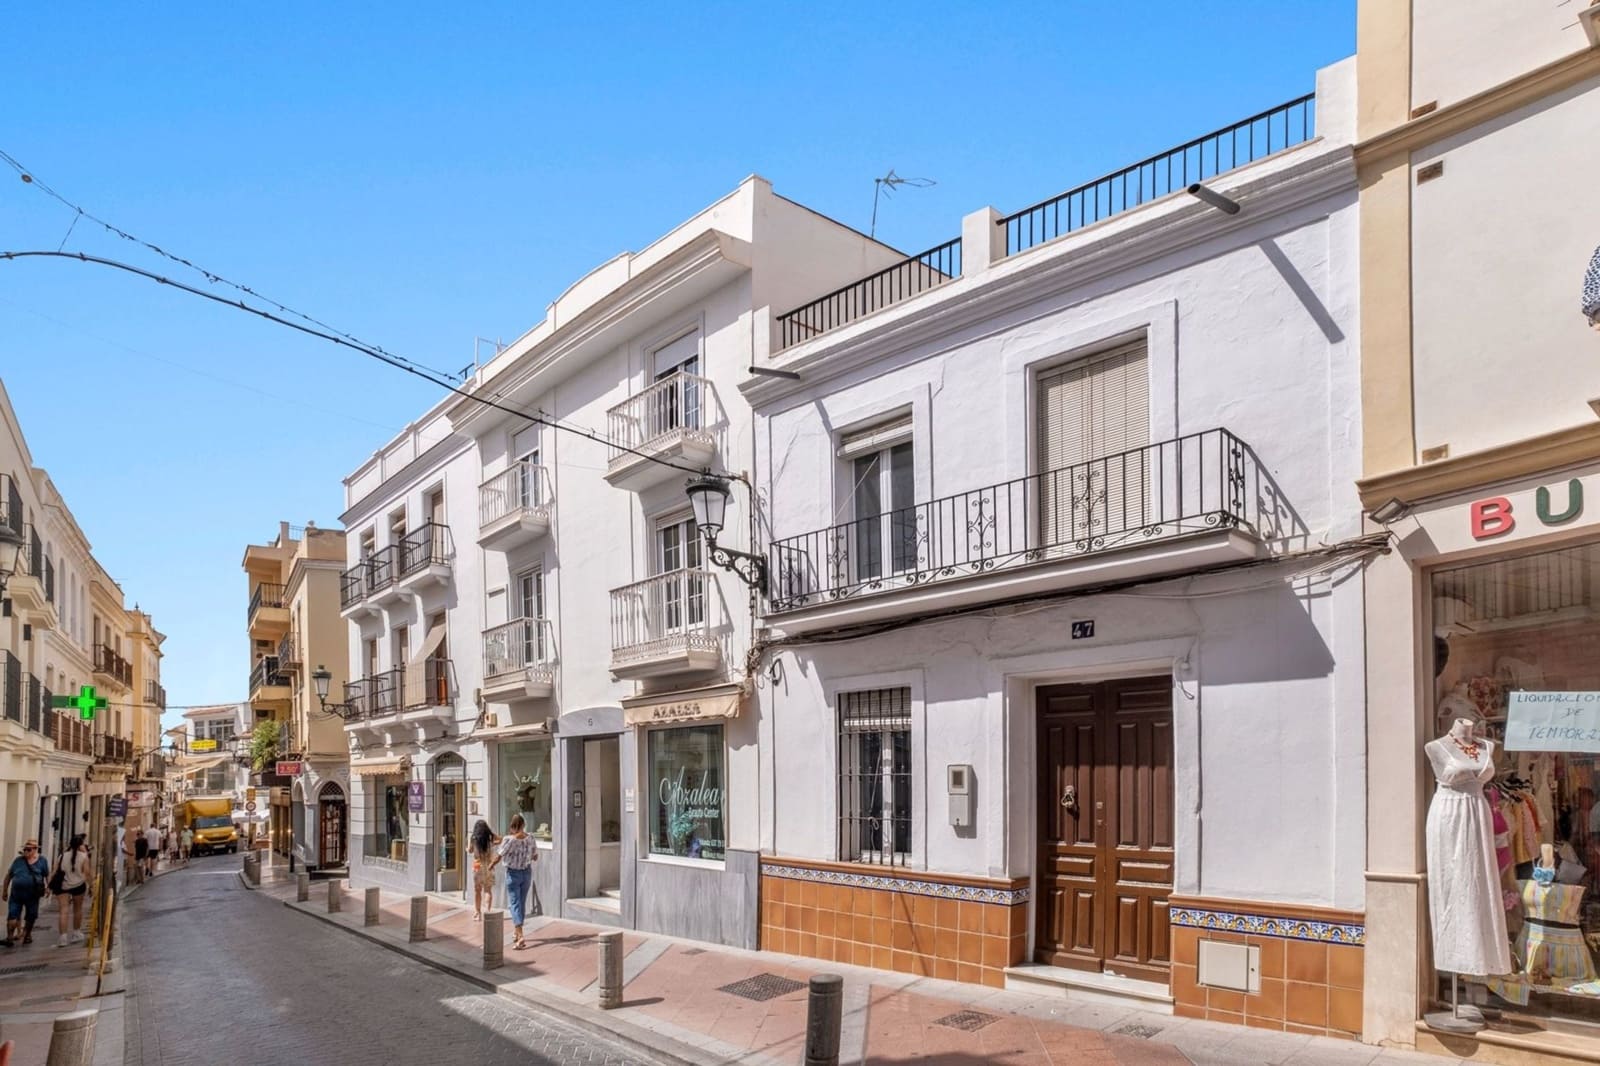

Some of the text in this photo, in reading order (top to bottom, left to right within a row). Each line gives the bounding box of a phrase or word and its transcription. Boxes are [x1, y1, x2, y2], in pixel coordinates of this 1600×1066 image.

[1073, 622, 1092, 637] 47
[652, 703, 701, 719] AZALEA
[659, 765, 720, 807] Azalea
